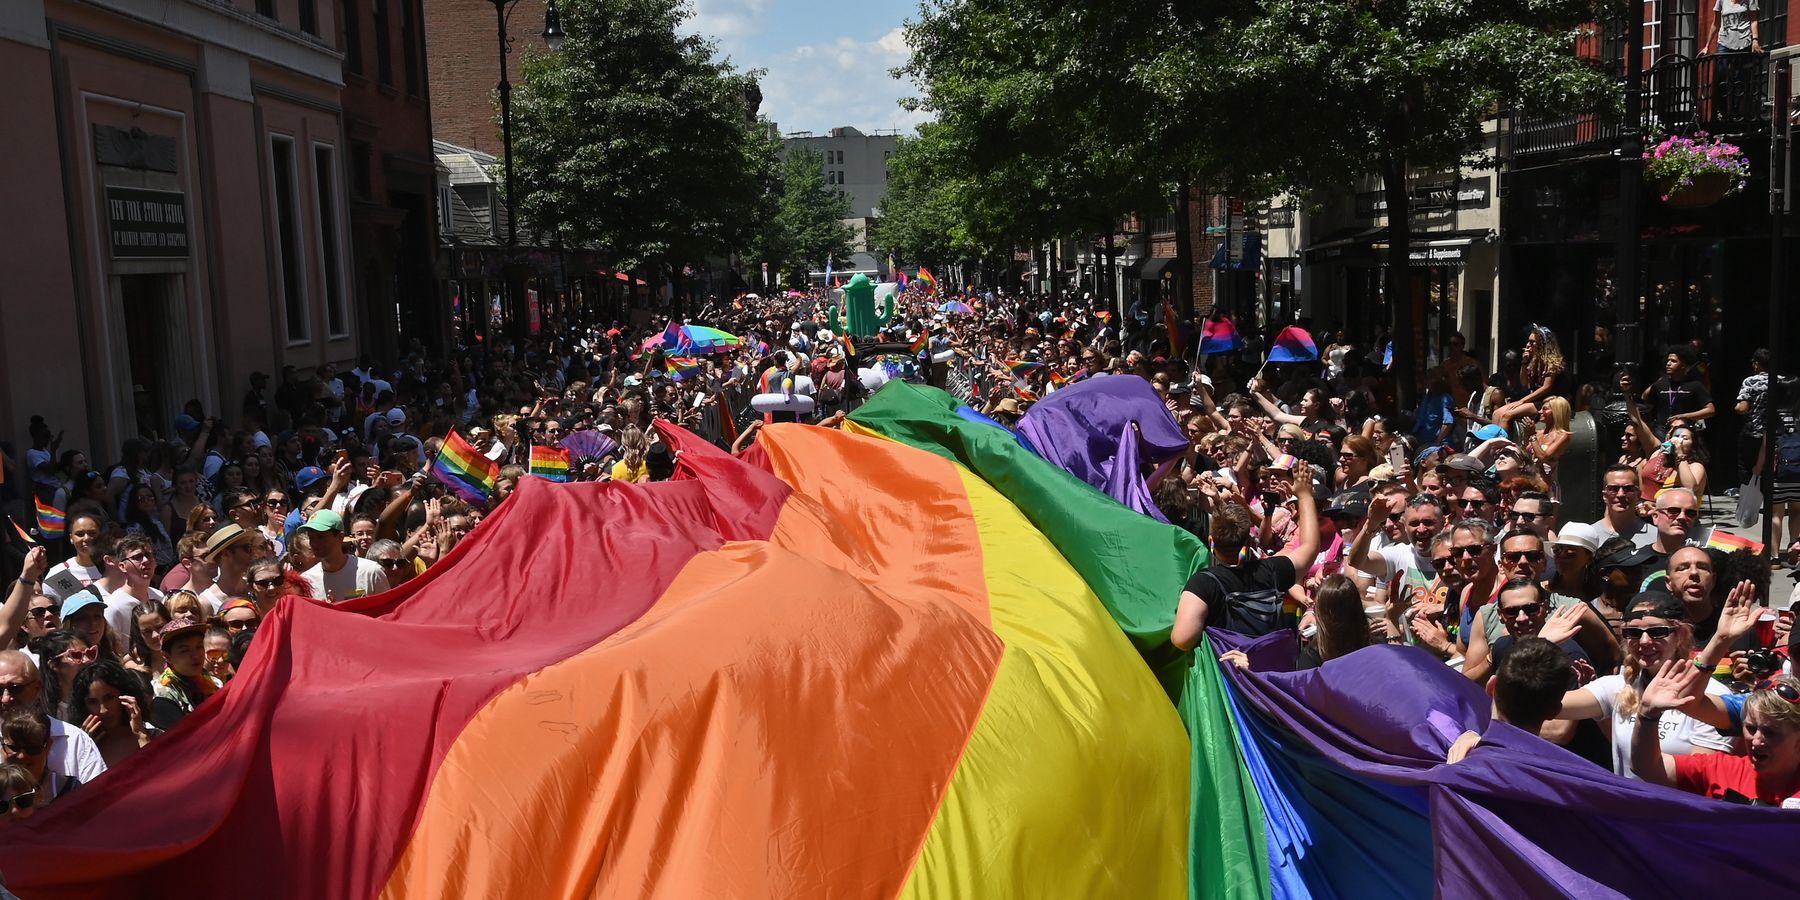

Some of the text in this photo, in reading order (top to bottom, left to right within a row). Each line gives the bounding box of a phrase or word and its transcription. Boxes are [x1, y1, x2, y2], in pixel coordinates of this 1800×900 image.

[125, 200, 142, 222] YORK
[143, 201, 163, 223] STUDIO
[164, 203, 185, 224] SCHOOL
[1429, 248, 1433, 259] &
[1433, 248, 1461, 260] Supplements
[1629, 716, 1680, 731] PECT
